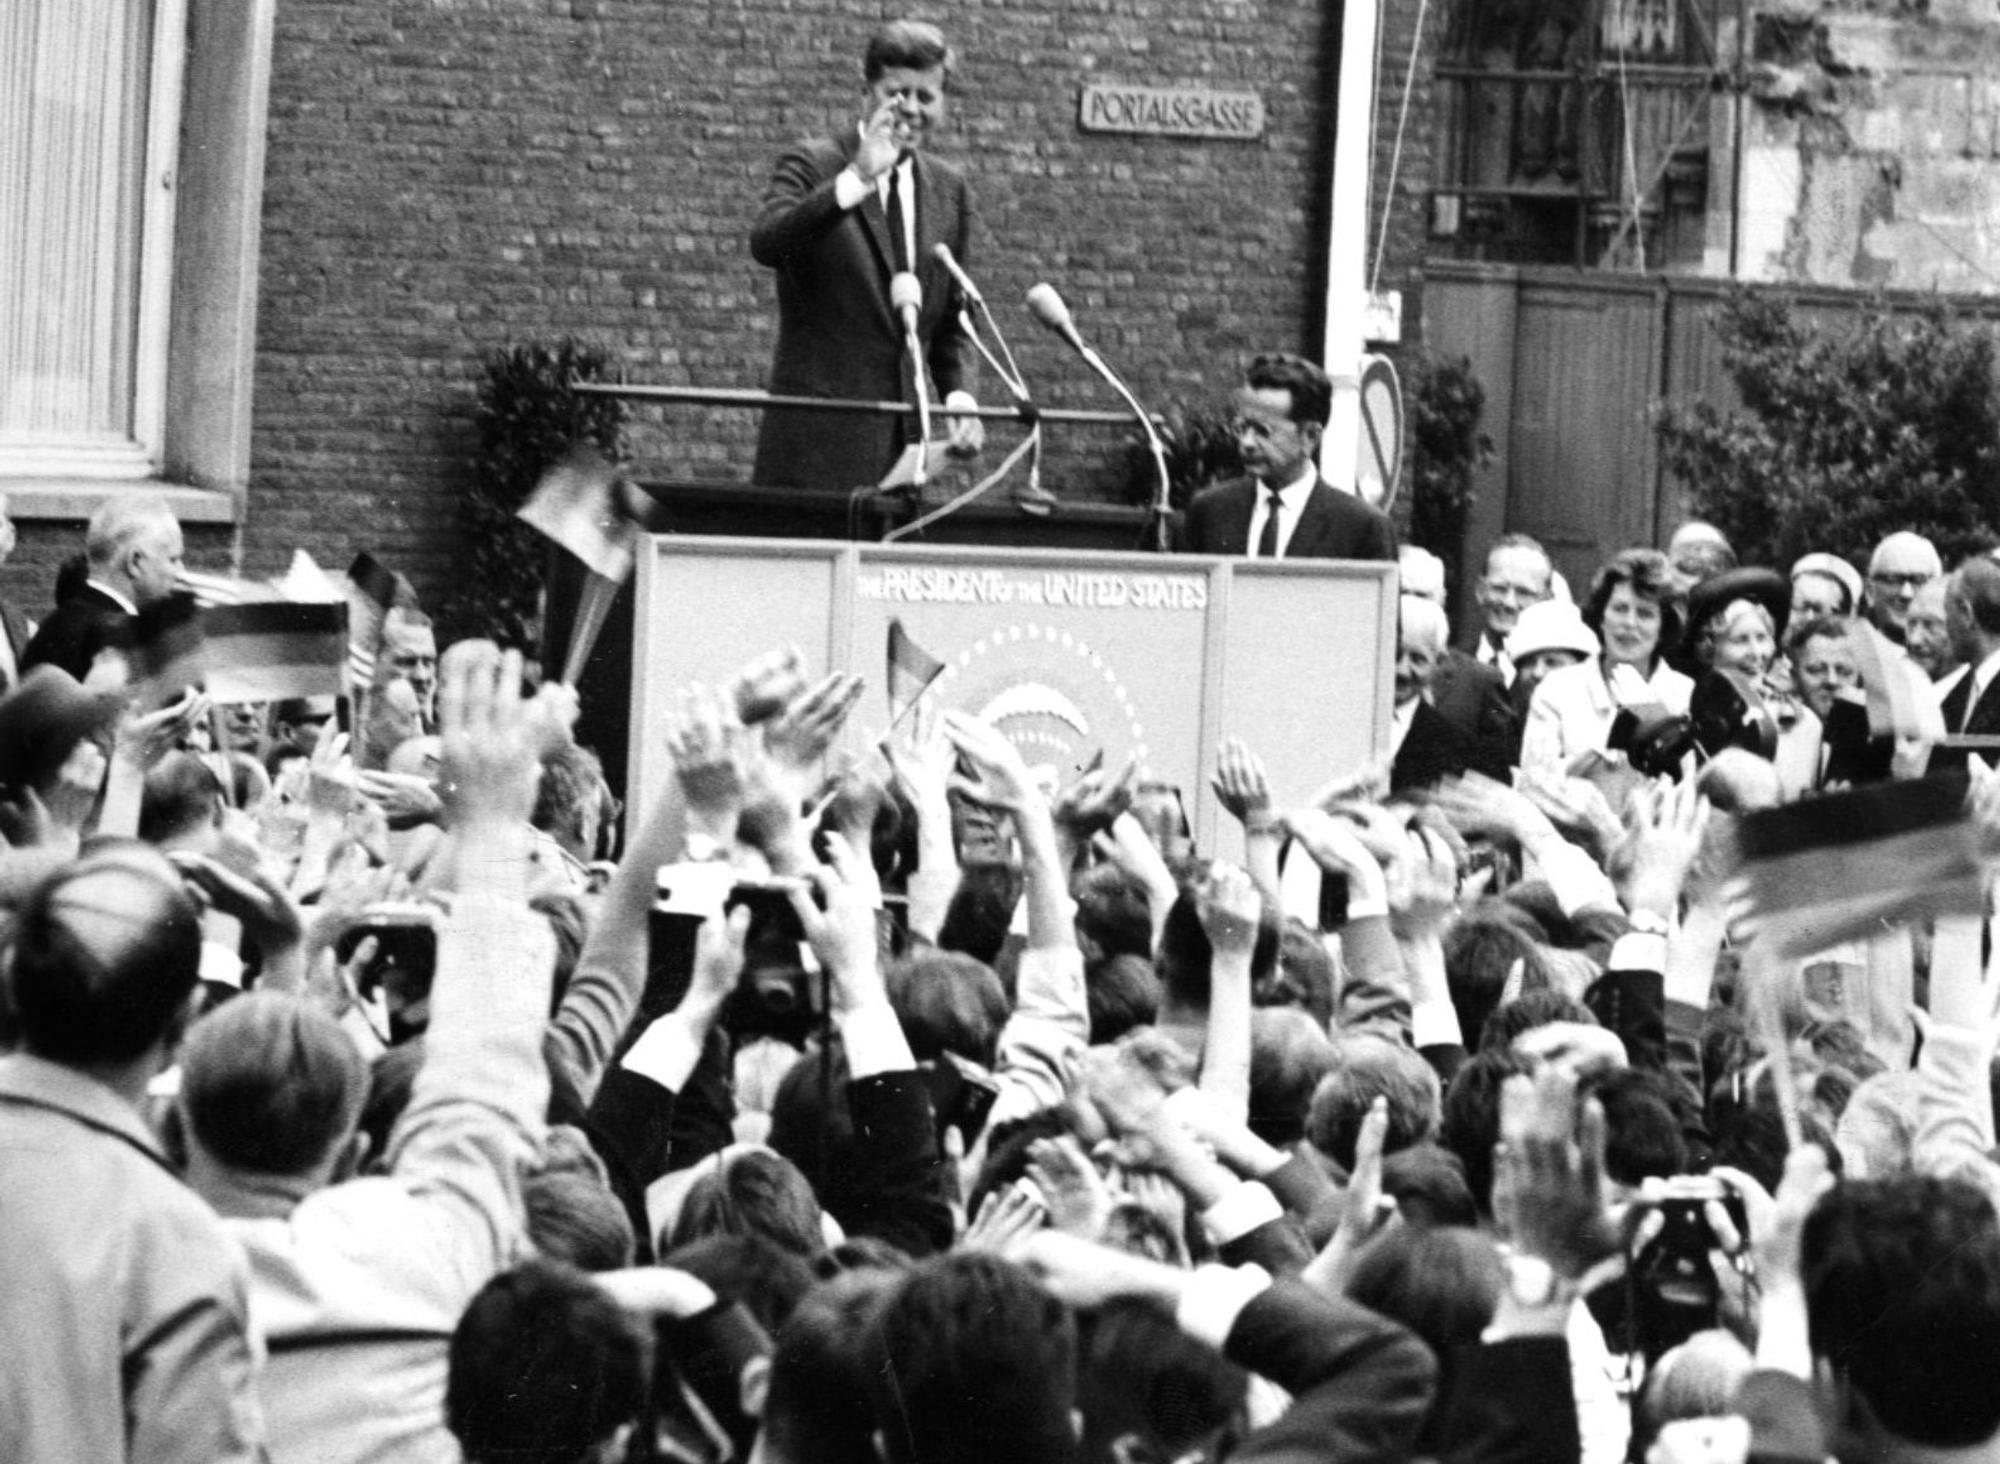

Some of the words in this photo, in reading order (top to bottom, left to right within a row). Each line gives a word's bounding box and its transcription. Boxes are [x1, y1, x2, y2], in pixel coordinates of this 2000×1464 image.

[1092, 91, 1256, 131] PORTALSGASSE
[884, 568, 1002, 602] PRESIDENT
[1043, 573, 1127, 606] UNITED
[1130, 576, 1206, 608] STATES
